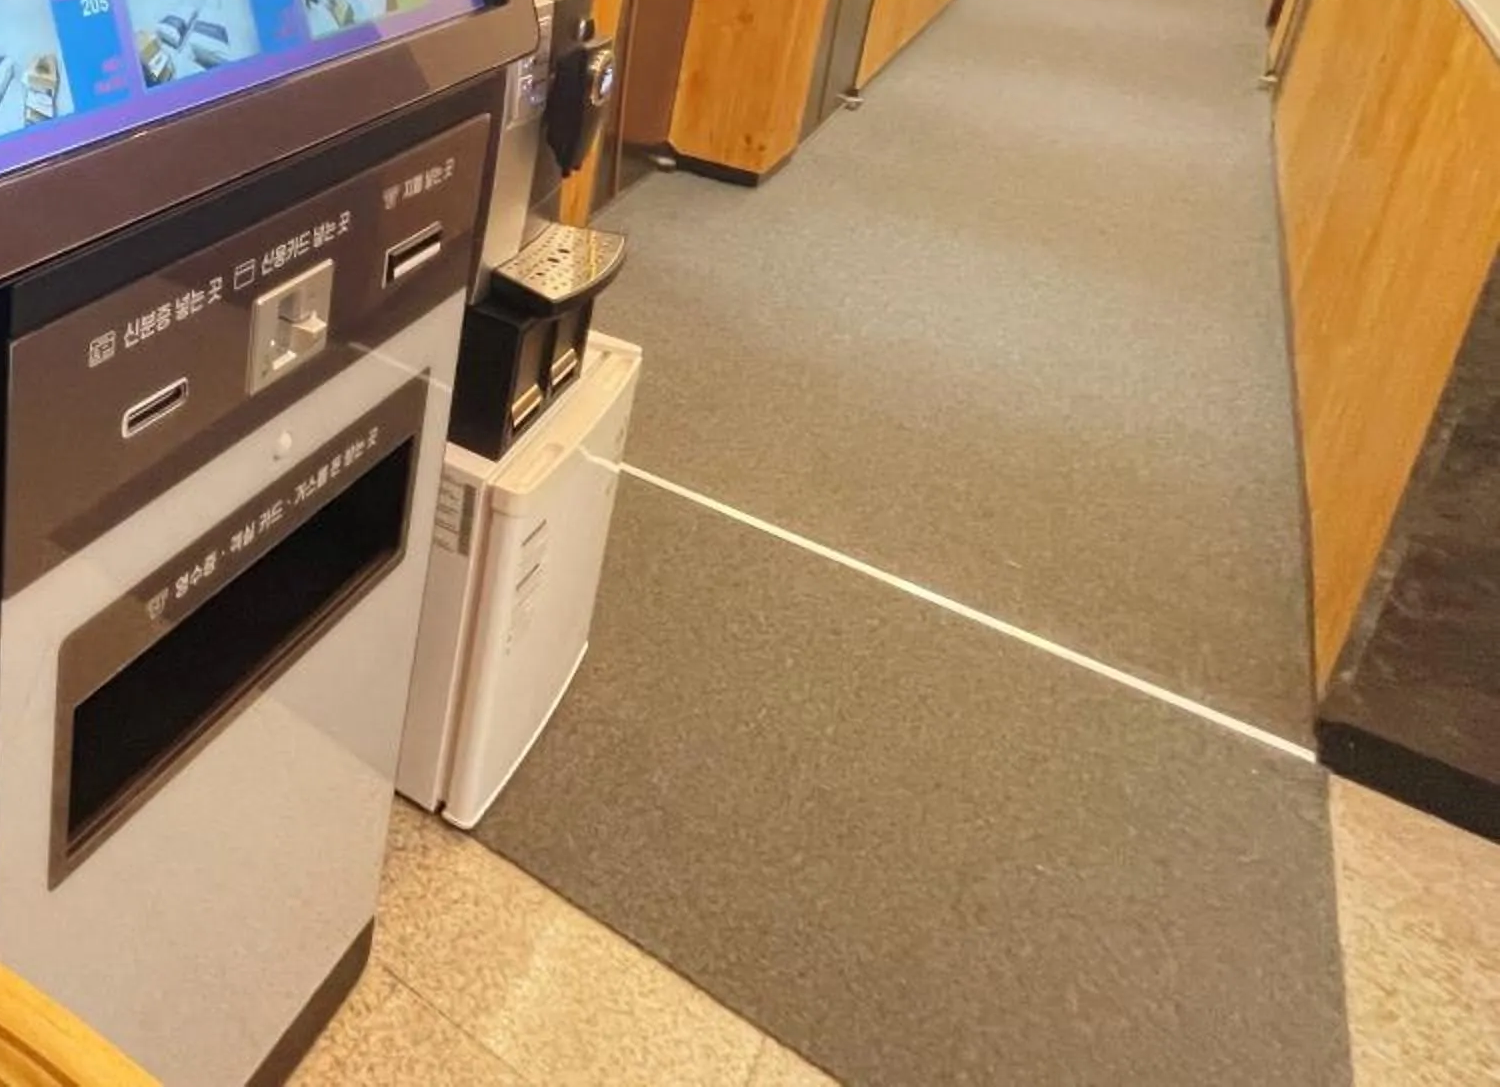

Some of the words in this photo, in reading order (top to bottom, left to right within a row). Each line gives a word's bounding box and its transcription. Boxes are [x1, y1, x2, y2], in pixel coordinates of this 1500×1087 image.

[261, 230, 311, 276] 신용카드
[313, 221, 337, 248] 넣는
[338, 210, 351, 236] 곳
[123, 303, 173, 349] 신분증
[174, 289, 205, 323] 넣는
[207, 276, 224, 305] 곳
[258, 499, 284, 535] 카드
